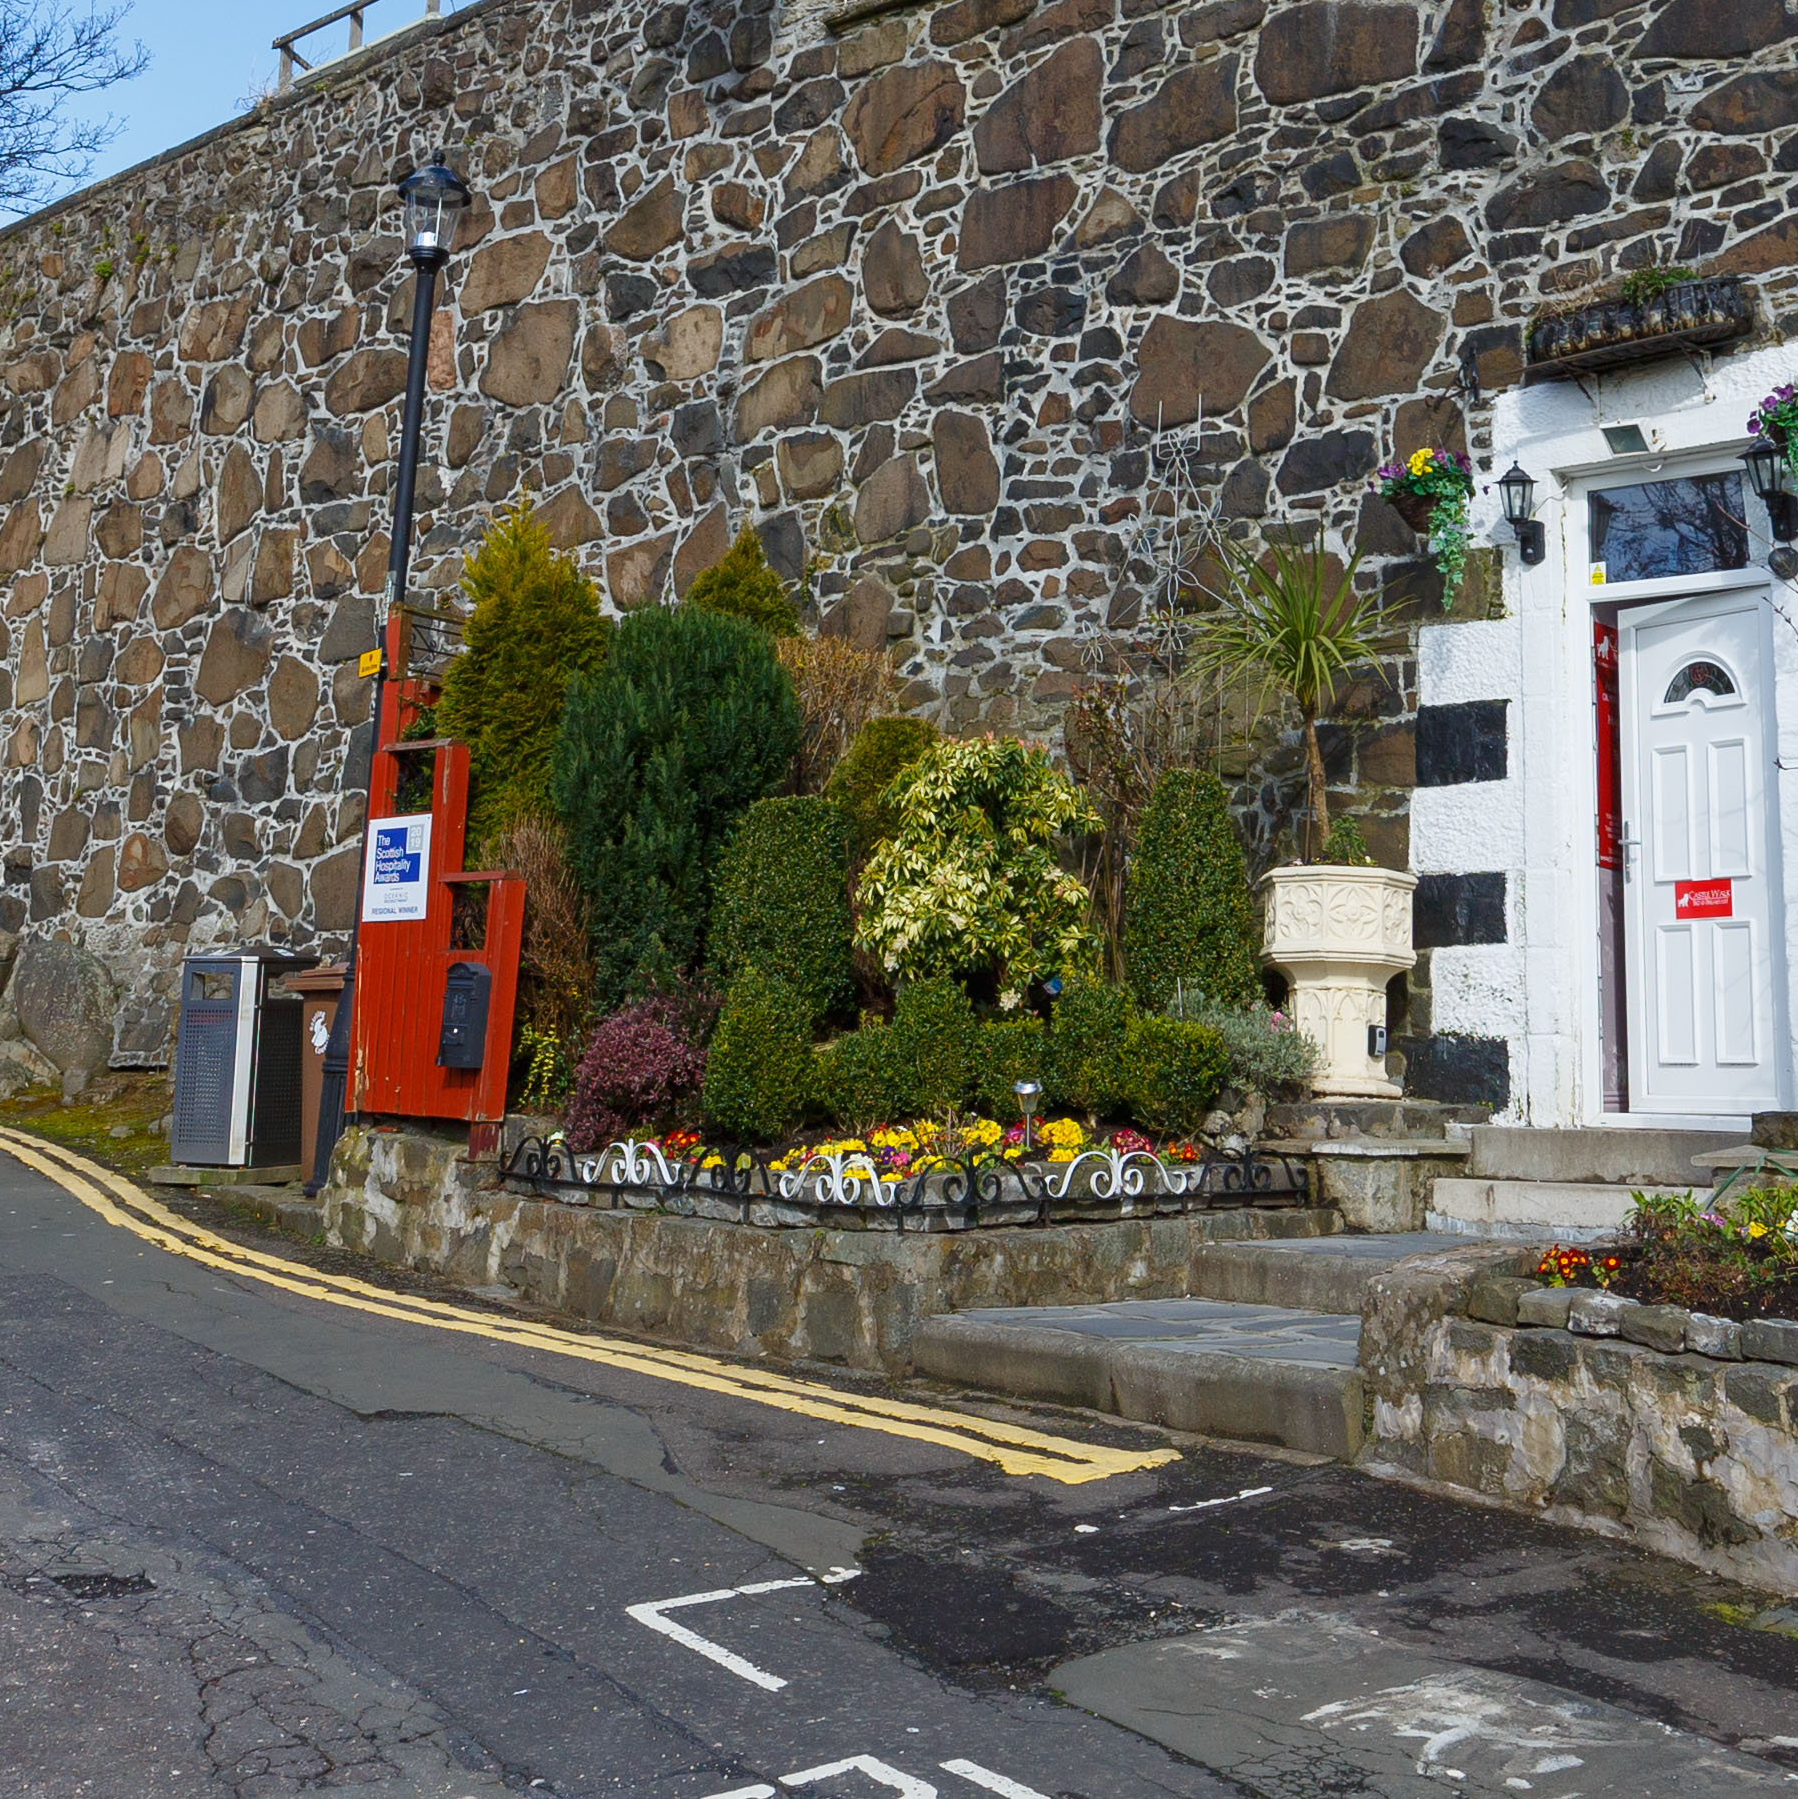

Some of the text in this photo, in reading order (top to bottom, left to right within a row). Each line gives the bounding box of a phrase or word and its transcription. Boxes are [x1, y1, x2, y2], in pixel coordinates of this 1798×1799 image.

[410, 826, 422, 837] 20
[377, 835, 391, 847] The
[409, 837, 421, 848] 19
[376, 846, 404, 860] Scottish
[375, 859, 411, 874] Hospitality
[374, 872, 400, 883] Awards
[371, 905, 418, 915] REGIONAL WINNER
